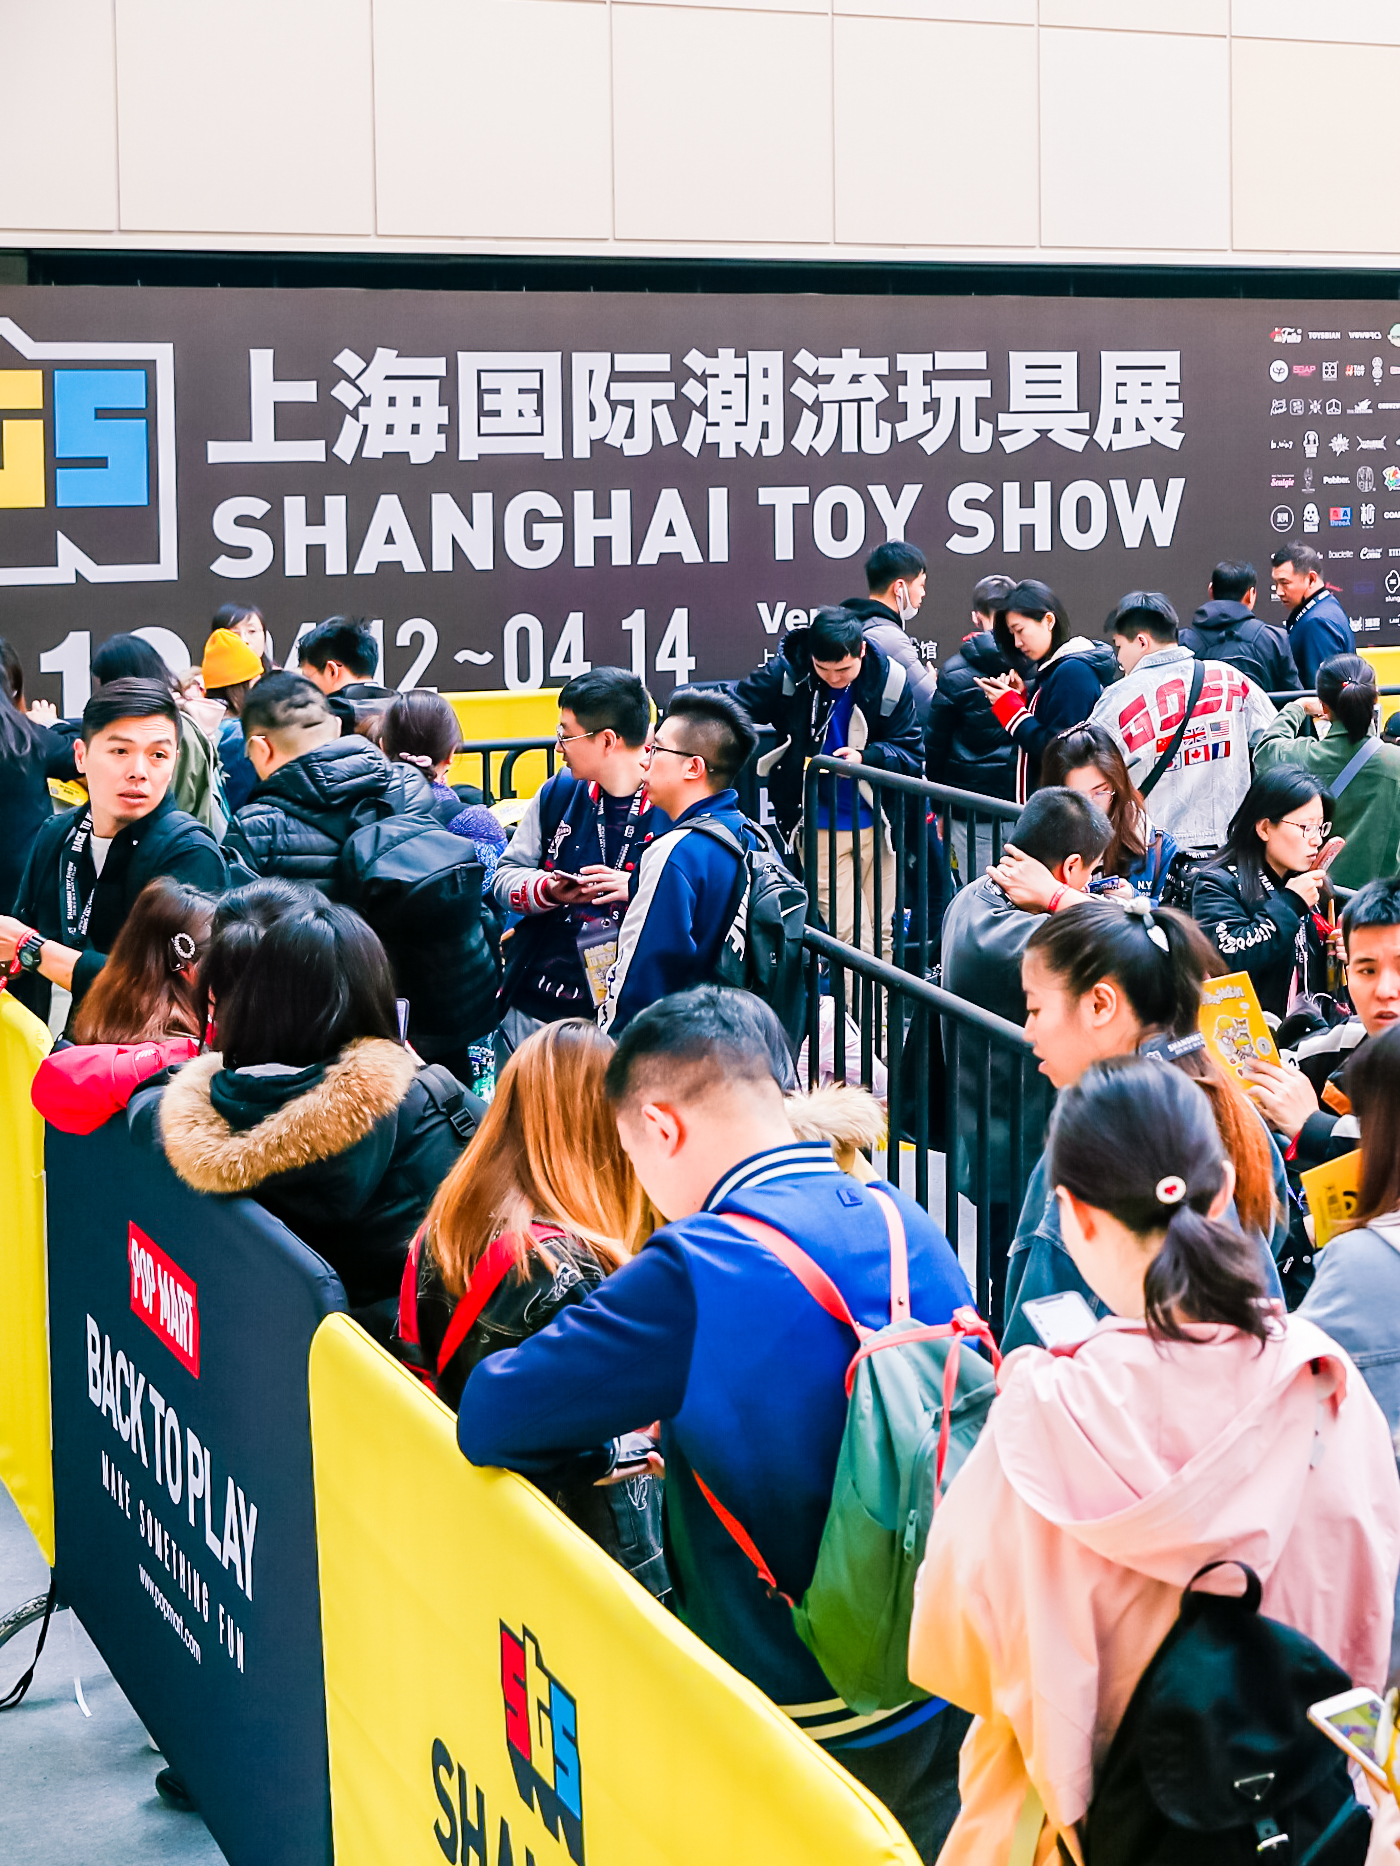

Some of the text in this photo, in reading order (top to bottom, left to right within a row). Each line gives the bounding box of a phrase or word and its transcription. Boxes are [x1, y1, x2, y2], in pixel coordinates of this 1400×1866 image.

[207, 346, 1186, 465] 上海国际潮流玩具展
[209, 477, 1186, 579] SHANGHAI TOY SHOW
[131, 1238, 195, 1359] POP MART
[86, 1312, 258, 1602] BACK TO PLAY
[101, 1450, 245, 1674] MAKE SOMETHING FUN
[138, 1563, 202, 1666] www.popmart.com
